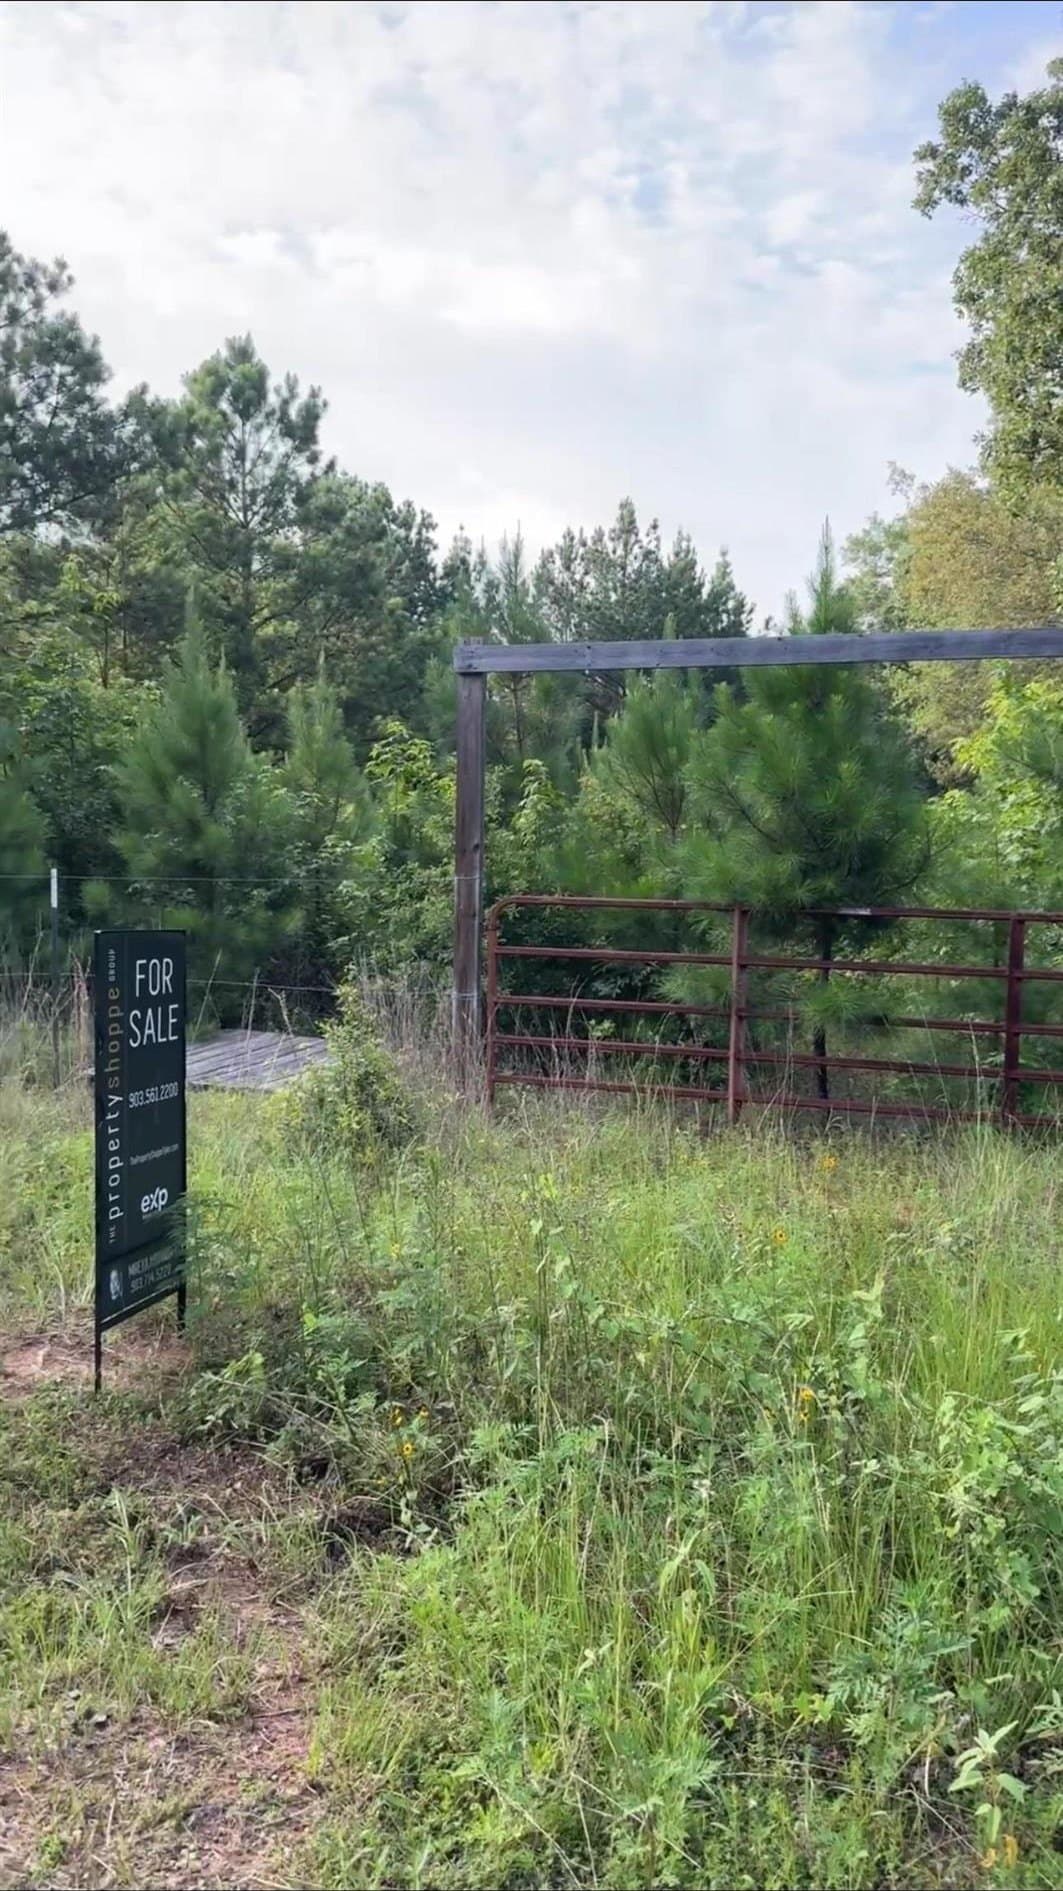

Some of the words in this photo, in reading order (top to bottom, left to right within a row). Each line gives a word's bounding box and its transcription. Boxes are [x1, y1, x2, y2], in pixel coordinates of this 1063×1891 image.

[135, 957, 174, 998] FOR
[128, 1003, 179, 1048] SALE
[140, 1186, 168, 1213] exp
